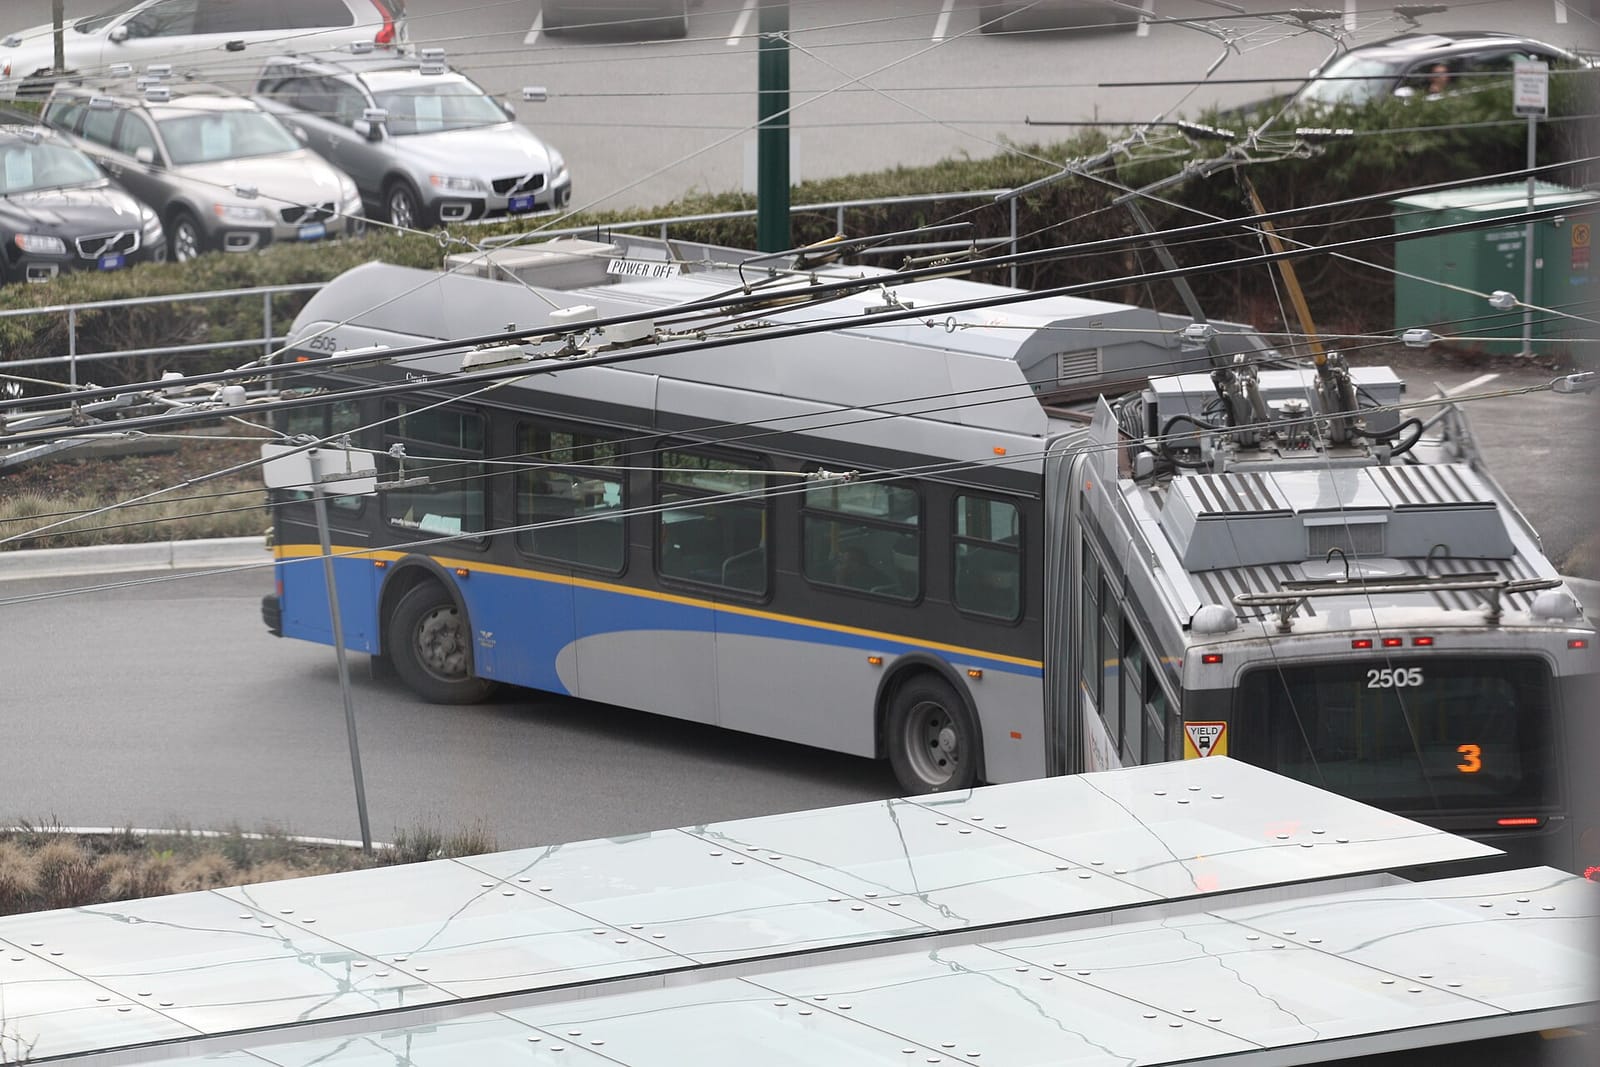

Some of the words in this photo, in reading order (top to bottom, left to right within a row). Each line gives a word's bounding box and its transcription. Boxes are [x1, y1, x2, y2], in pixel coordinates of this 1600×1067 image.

[611, 260, 650, 277] POWER
[652, 264, 675, 279] OFF
[309, 335, 337, 352] 2505
[1366, 667, 1425, 689] 2505
[1190, 726, 1219, 736] YIELD
[1456, 744, 1482, 773] 3
